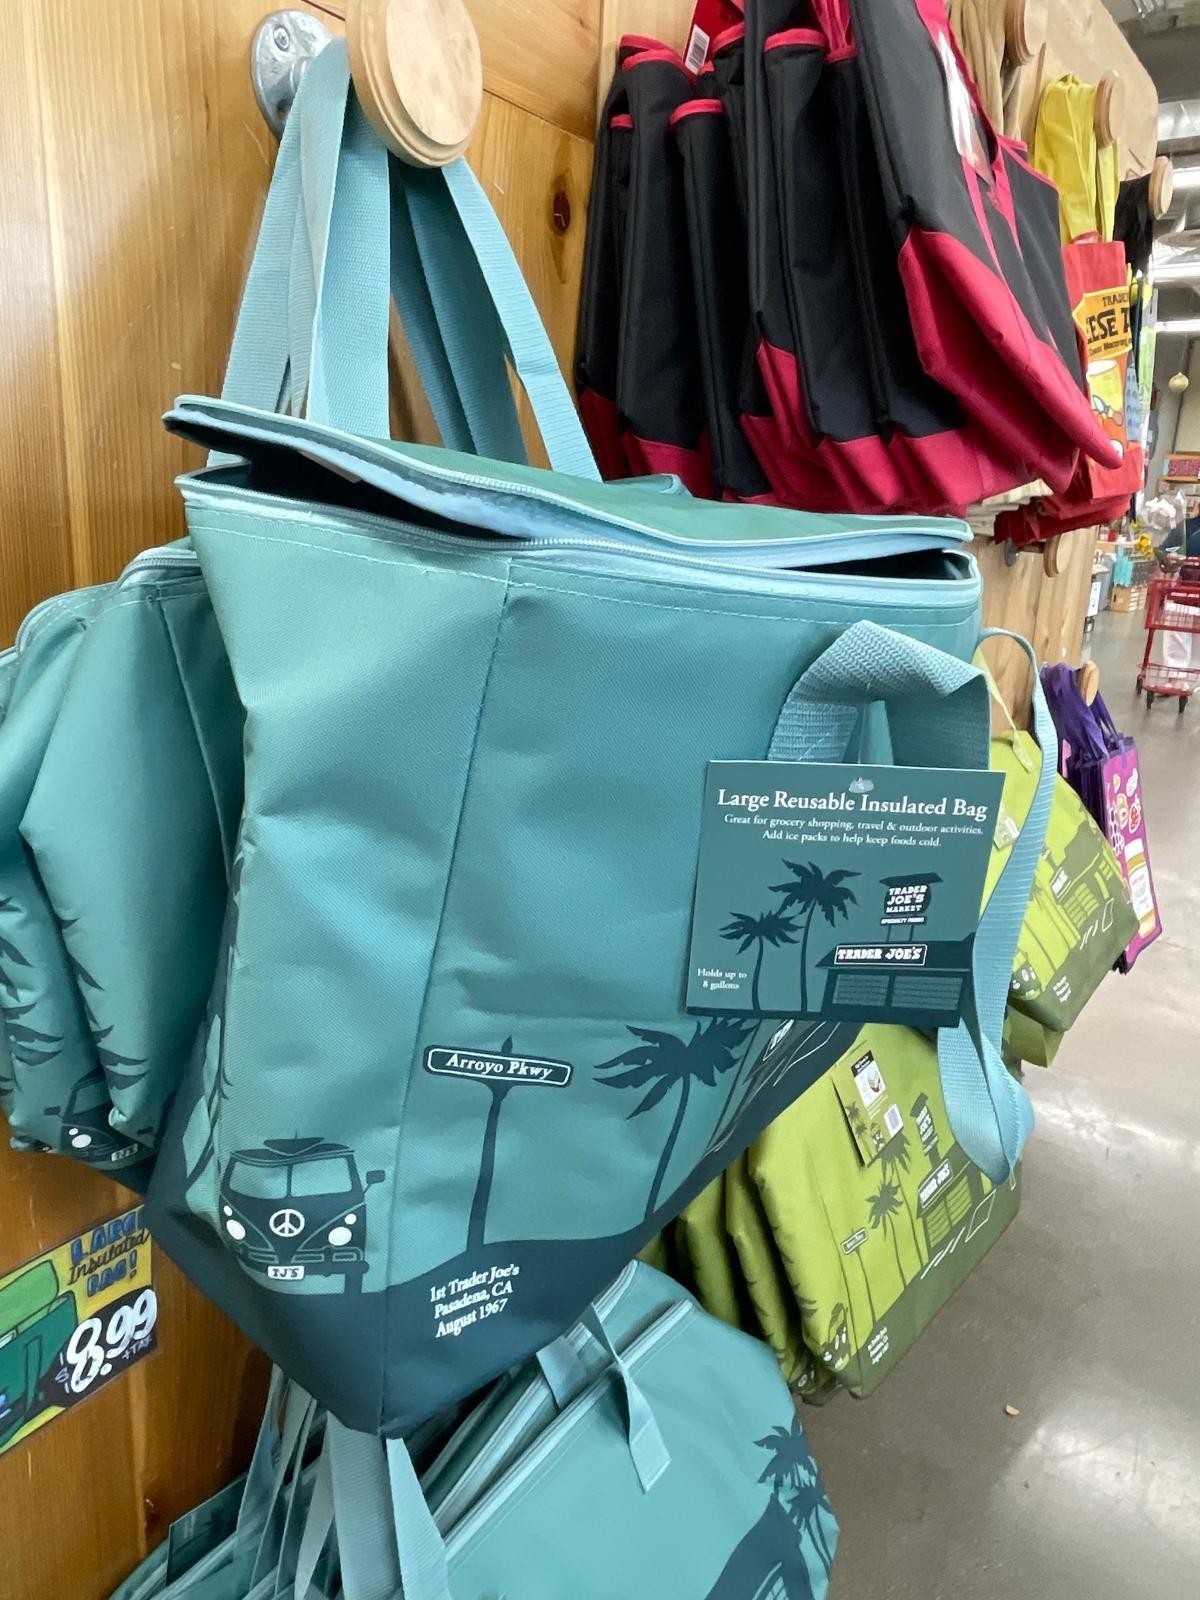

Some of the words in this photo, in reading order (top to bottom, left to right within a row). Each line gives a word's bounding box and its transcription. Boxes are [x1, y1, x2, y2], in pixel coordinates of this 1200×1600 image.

[717, 788, 770, 812] Large
[773, 790, 856, 811] Reusable
[860, 794, 948, 815] Insulated
[952, 798, 988, 822] Bag
[724, 813, 751, 824] Great
[753, 815, 768, 825] for
[769, 817, 806, 829] grocery
[808, 817, 855, 831] shopping,
[857, 820, 885, 830] travel
[886, 822, 897, 831] &
[899, 822, 938, 833] outdoor
[940, 824, 984, 835] activities.
[762, 829, 783, 840] Add
[786, 831, 800, 840] ice
[801, 832, 828, 843] packs
[830, 834, 841, 842] to
[842, 833, 864, 846] help
[866, 834, 889, 847] keep
[890, 835, 916, 846] foods
[919, 837, 942, 847] cold.
[886, 894, 925, 905] JOE'S
[888, 885, 928, 896] TRADER
[885, 905, 922, 914] MARKET
[837, 948, 883, 960] TRADER
[885, 946, 923, 960] JOE'S
[697, 967, 723, 978] Holds
[724, 972, 737, 980] up
[710, 980, 740, 991] gallons
[445, 1053, 504, 1076] Arroyo
[507, 1060, 553, 1081] Pkwy
[71, 1211, 142, 1266] LARG
[67, 1227, 150, 1286] Insulated
[430, 1285, 447, 1302] 1st
[448, 1270, 489, 1296] Trader
[487, 1263, 520, 1285] Joe's
[434, 1289, 491, 1320] Pasadena,
[491, 1280, 514, 1297] CA
[435, 1310, 477, 1339] August
[479, 1297, 509, 1320] 1967
